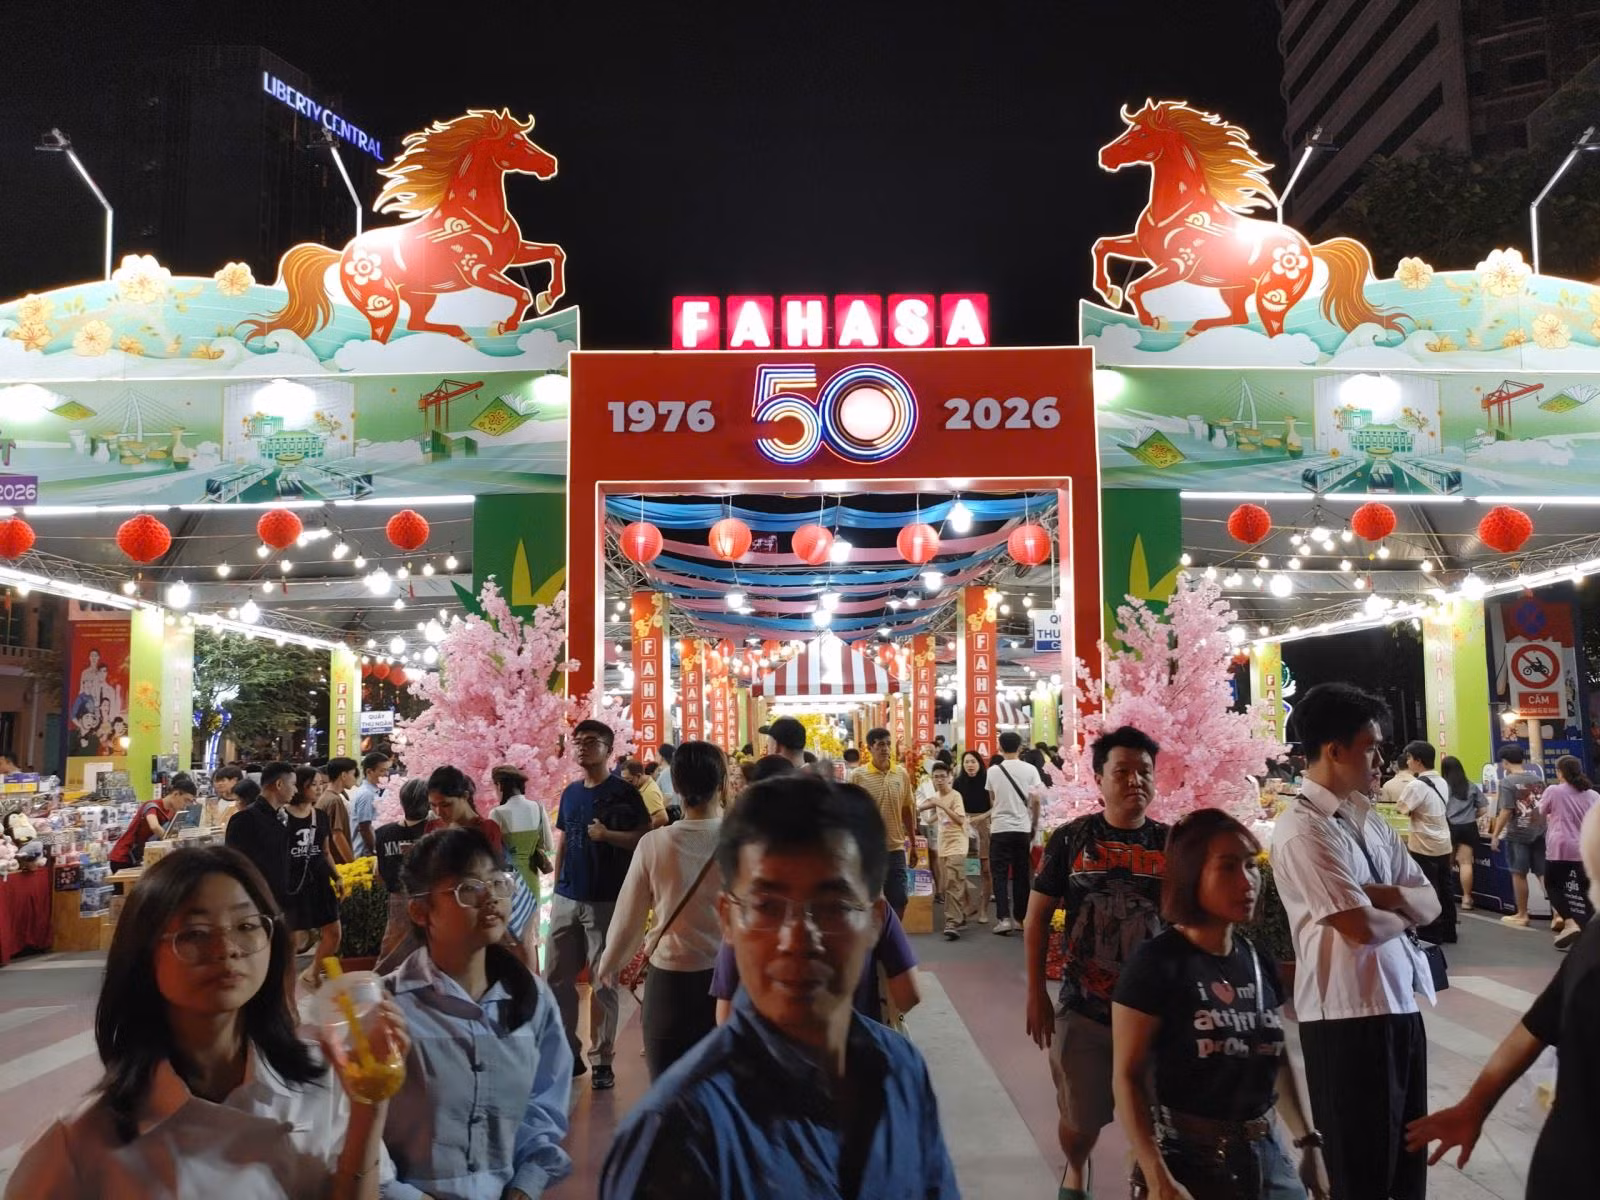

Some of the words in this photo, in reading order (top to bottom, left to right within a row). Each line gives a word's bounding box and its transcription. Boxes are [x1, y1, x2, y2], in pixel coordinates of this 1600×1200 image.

[263, 71, 322, 120] LIBERTY
[321, 109, 384, 161] CENTRAL
[681, 298, 987, 348] FAHASA
[607, 400, 716, 433] 1976
[752, 363, 919, 465] 50
[944, 396, 1061, 430] 2026
[337, 683, 347, 756] FAHAS
[643, 638, 656, 763] FAHASA
[687, 672, 698, 742] FAHAS
[975, 634, 990, 757] FAHASA
